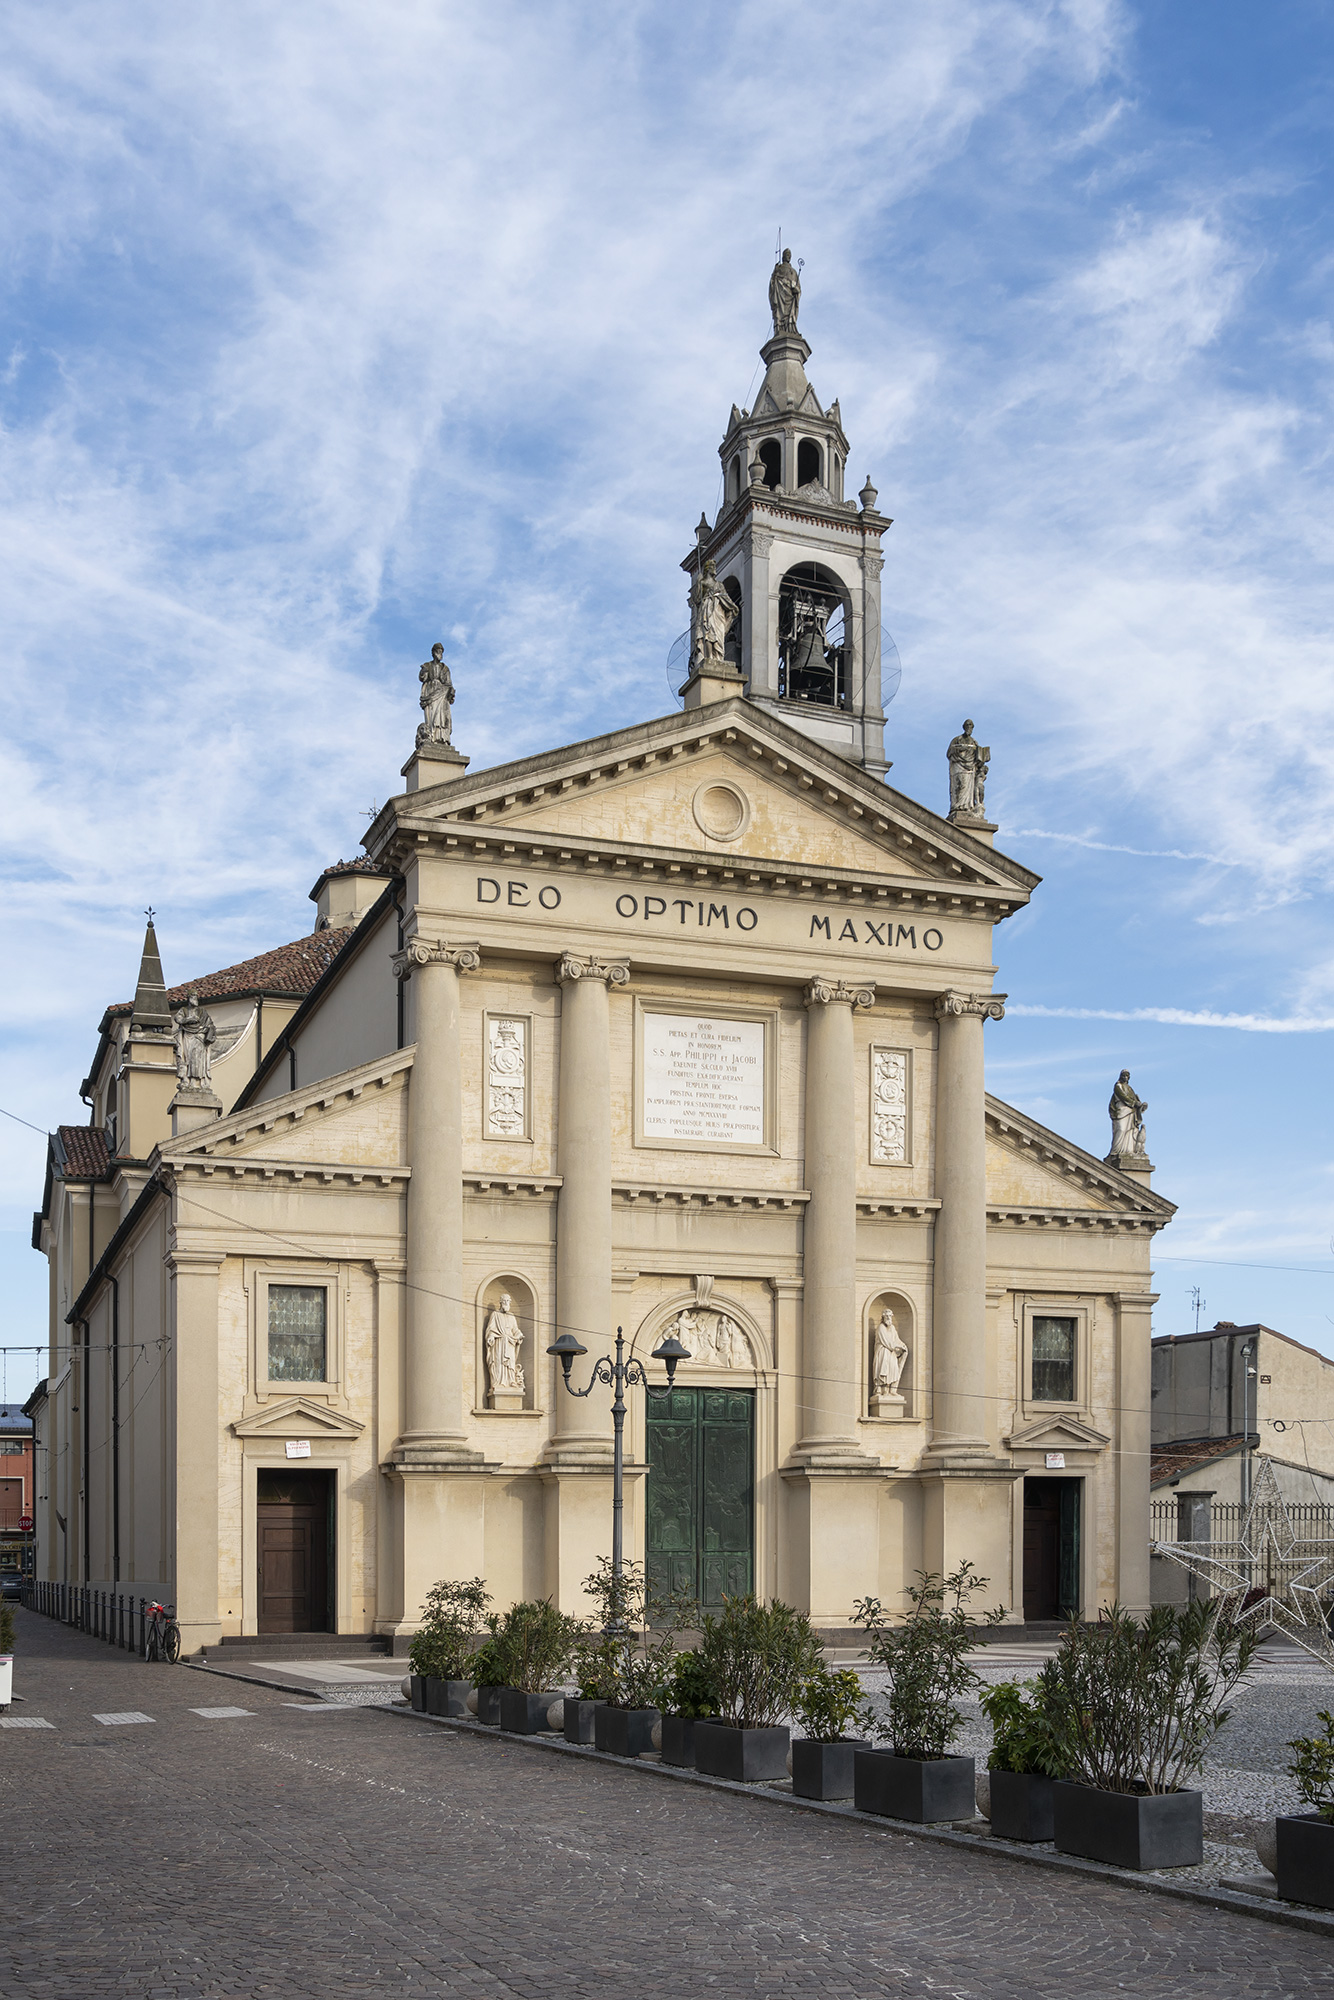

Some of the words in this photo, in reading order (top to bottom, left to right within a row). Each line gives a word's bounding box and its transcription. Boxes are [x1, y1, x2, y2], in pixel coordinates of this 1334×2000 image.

[477, 877, 562, 909] DEO
[615, 893, 758, 931] OPTIMO
[809, 914, 944, 951] MAXIMO
[697, 1023, 712, 1031] QUOD
[668, 1030, 688, 1038] PIETAS
[701, 1033, 715, 1041] CURA
[718, 1035, 742, 1043] FIDELIUM
[697, 1043, 722, 1051] HONOREM
[685, 1049, 717, 1062] PHILIPPI
[732, 1053, 757, 1065] JACOBI
[673, 1061, 697, 1070] EXEUNTE
[667, 1070, 694, 1079] FUNDITUS
[685, 1081, 709, 1089] TEMPLUM
[670, 1090, 693, 1098] PRISTINA
[696, 1091, 716, 1100] FRONTE
[719, 1093, 739, 1101] EVERSA
[646, 1116, 667, 1125] CLERUS
[669, 1118, 702, 1128] POPULUSQUE
